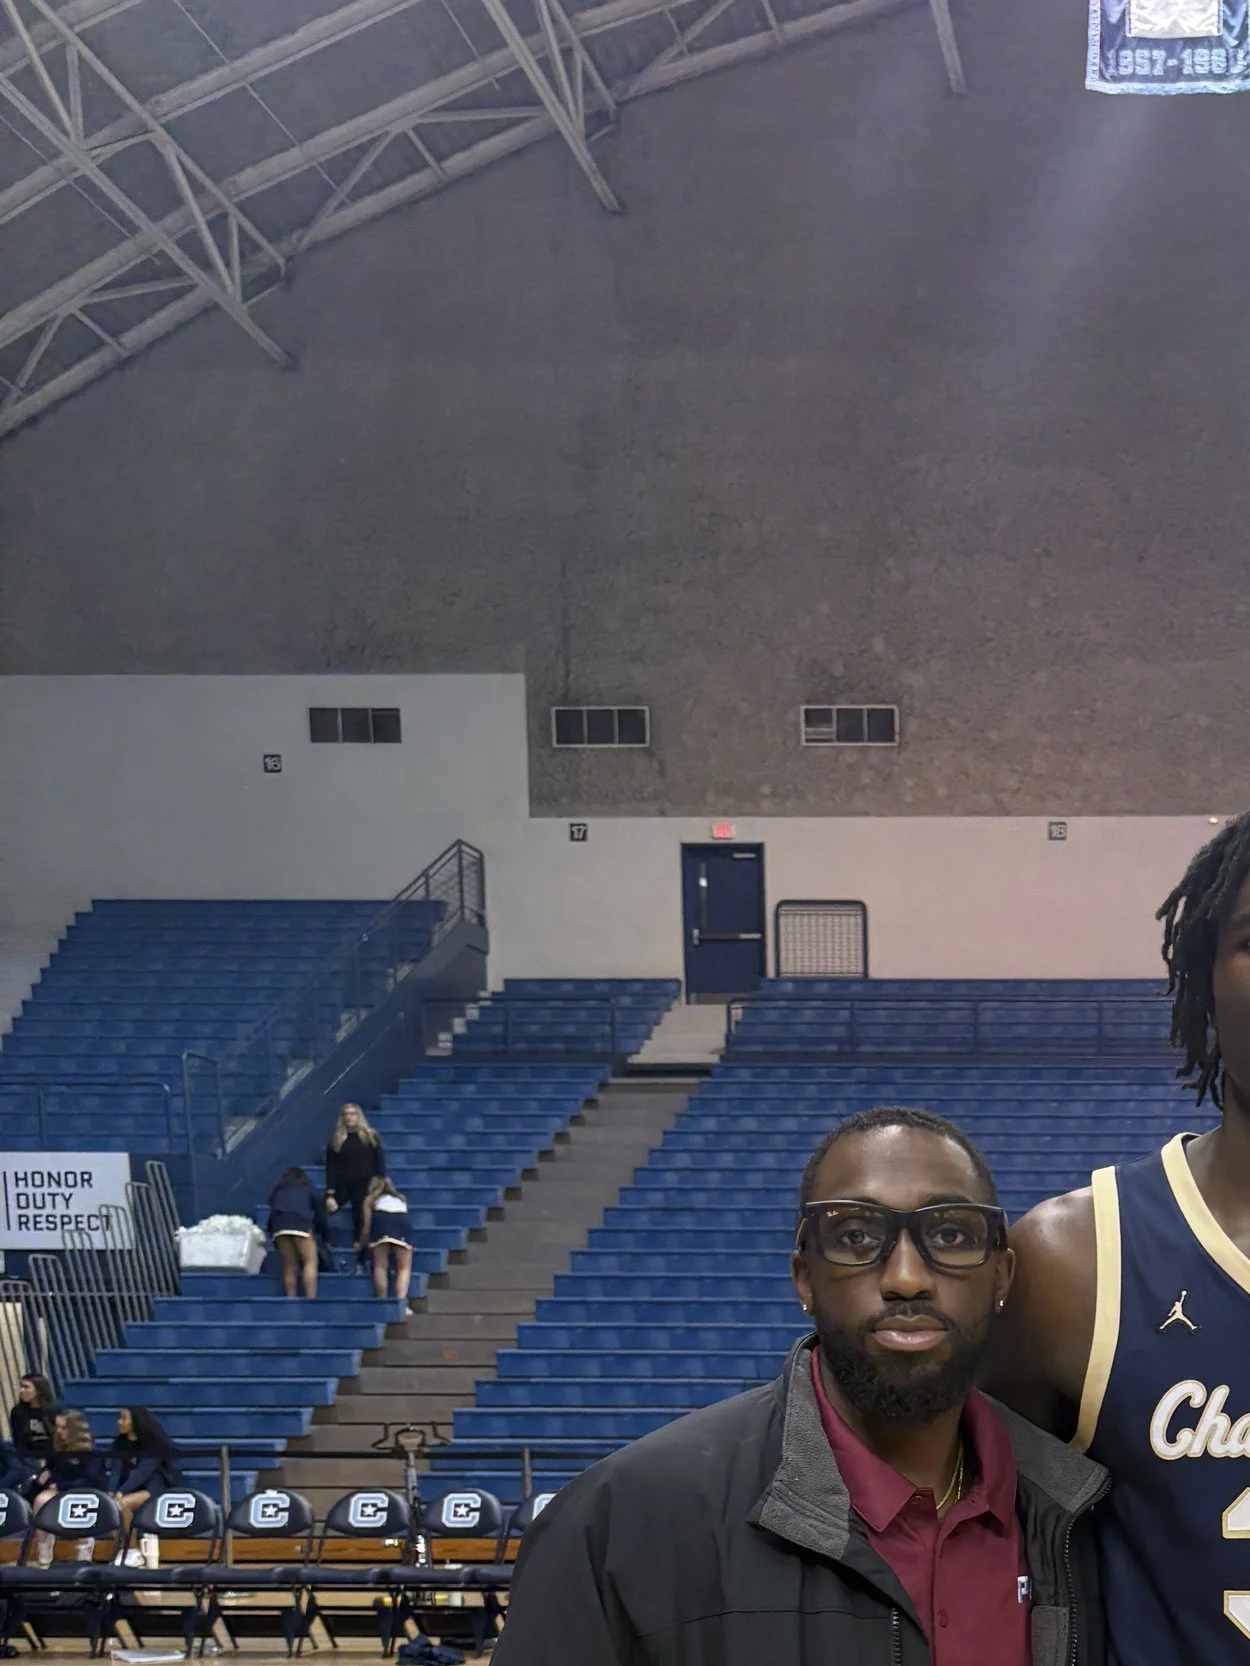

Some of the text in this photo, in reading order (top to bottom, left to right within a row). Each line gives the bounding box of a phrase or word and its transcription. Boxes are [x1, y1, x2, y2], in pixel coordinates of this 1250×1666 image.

[14, 1171, 93, 1188] HONOR
[16, 1192, 74, 1210] DUTY
[18, 1214, 112, 1232] RESPECT
